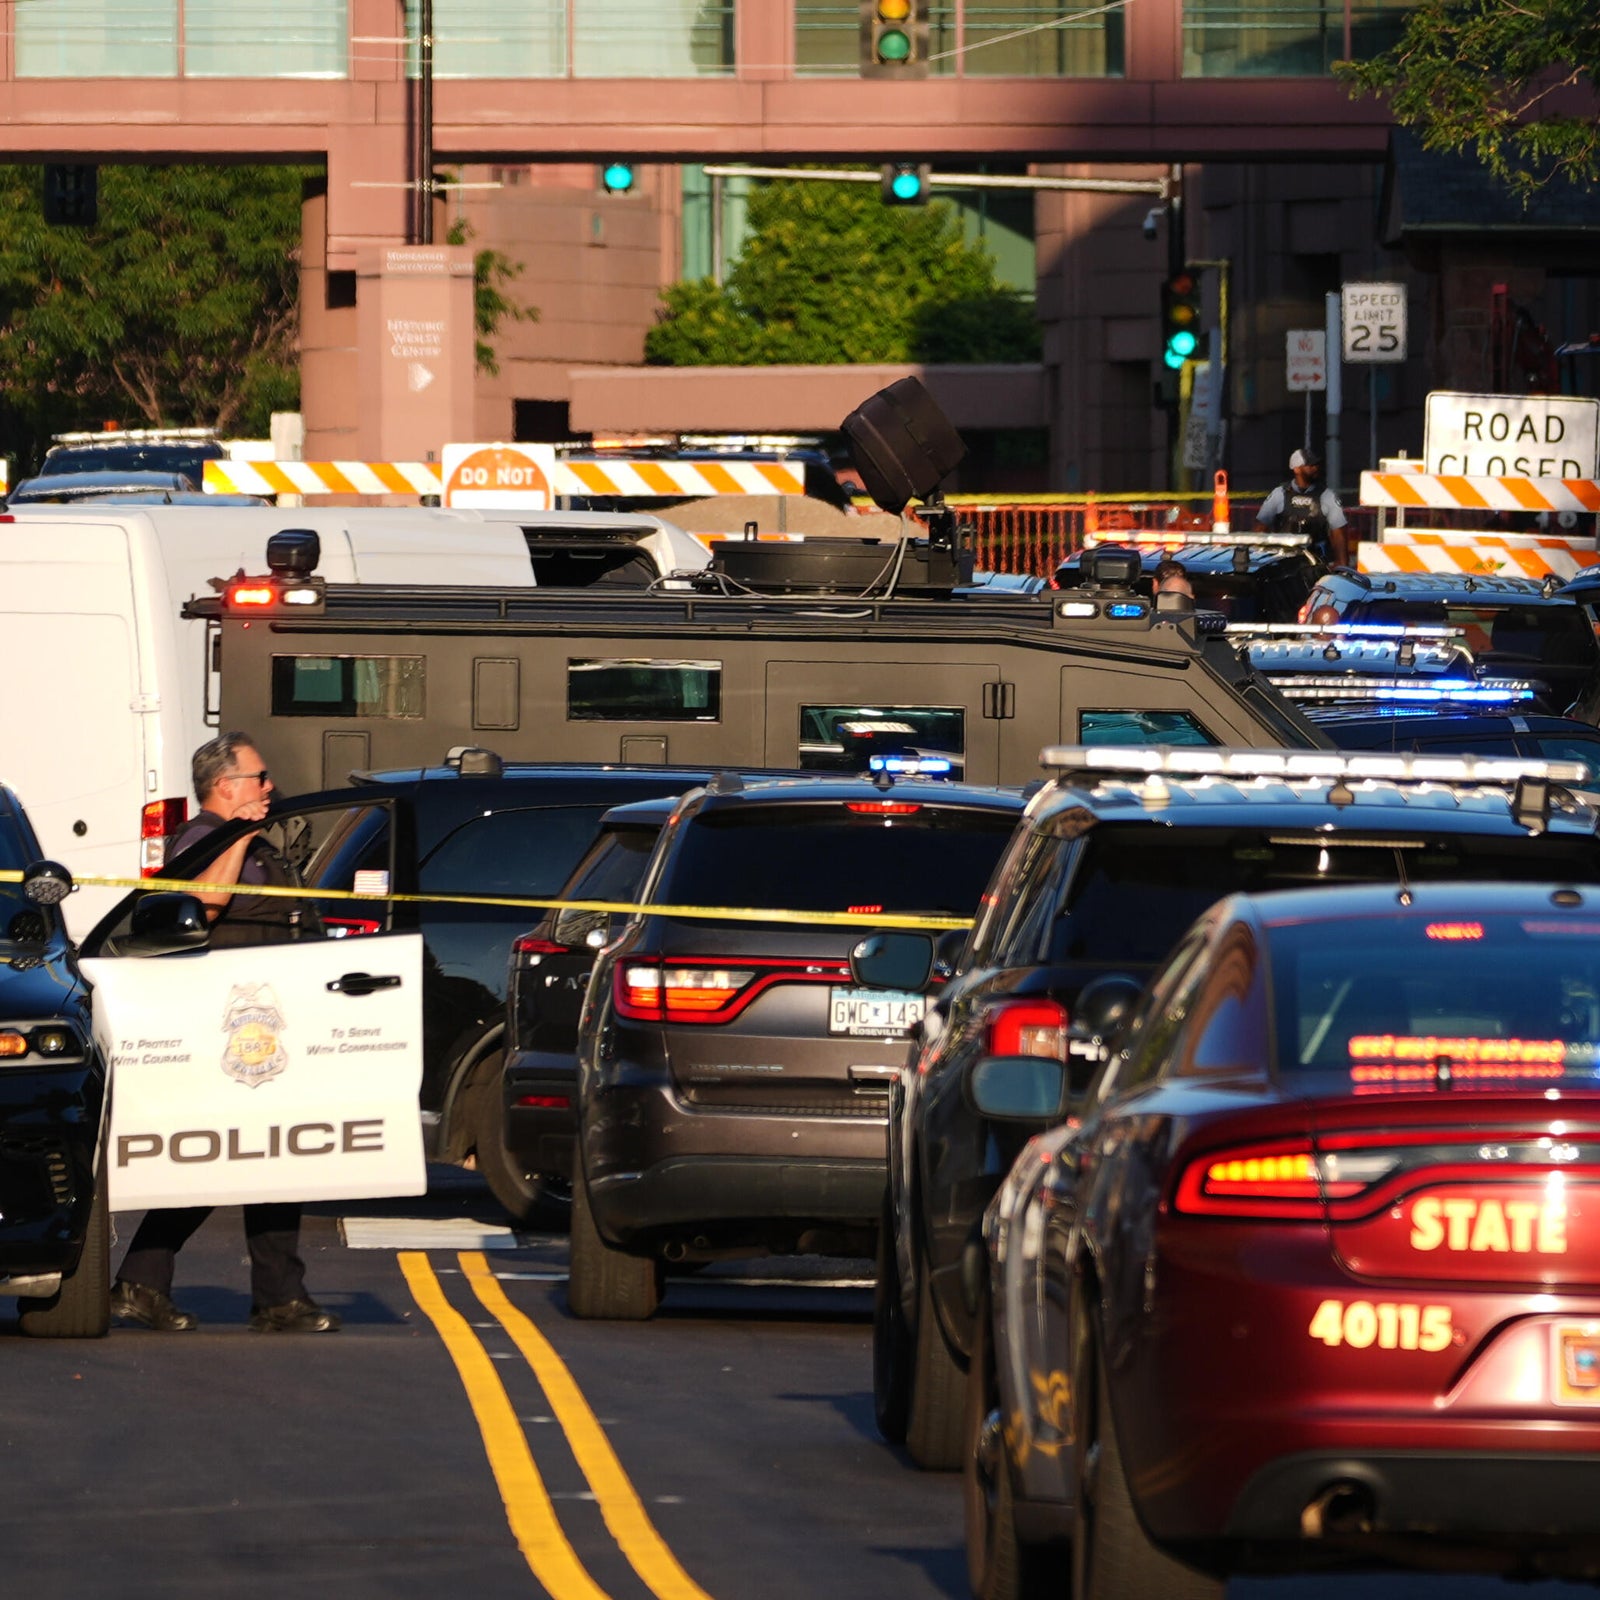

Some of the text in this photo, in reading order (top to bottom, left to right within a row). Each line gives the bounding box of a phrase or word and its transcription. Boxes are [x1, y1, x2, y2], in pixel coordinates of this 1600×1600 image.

[1349, 293, 1400, 306] SPEED
[1354, 308, 1393, 321] LIMIT
[1351, 325, 1399, 352] 25
[1464, 411, 1565, 443] ROAD
[460, 465, 535, 486] DO NOT
[834, 1001, 919, 1026] GWC 143
[849, 1026, 905, 1037] ROSEVILLE
[236, 1041, 272, 1055] 1887
[117, 1119, 384, 1168] POLICE
[1410, 1197, 1567, 1254] STATE
[1309, 1300, 1453, 1352] 40115
